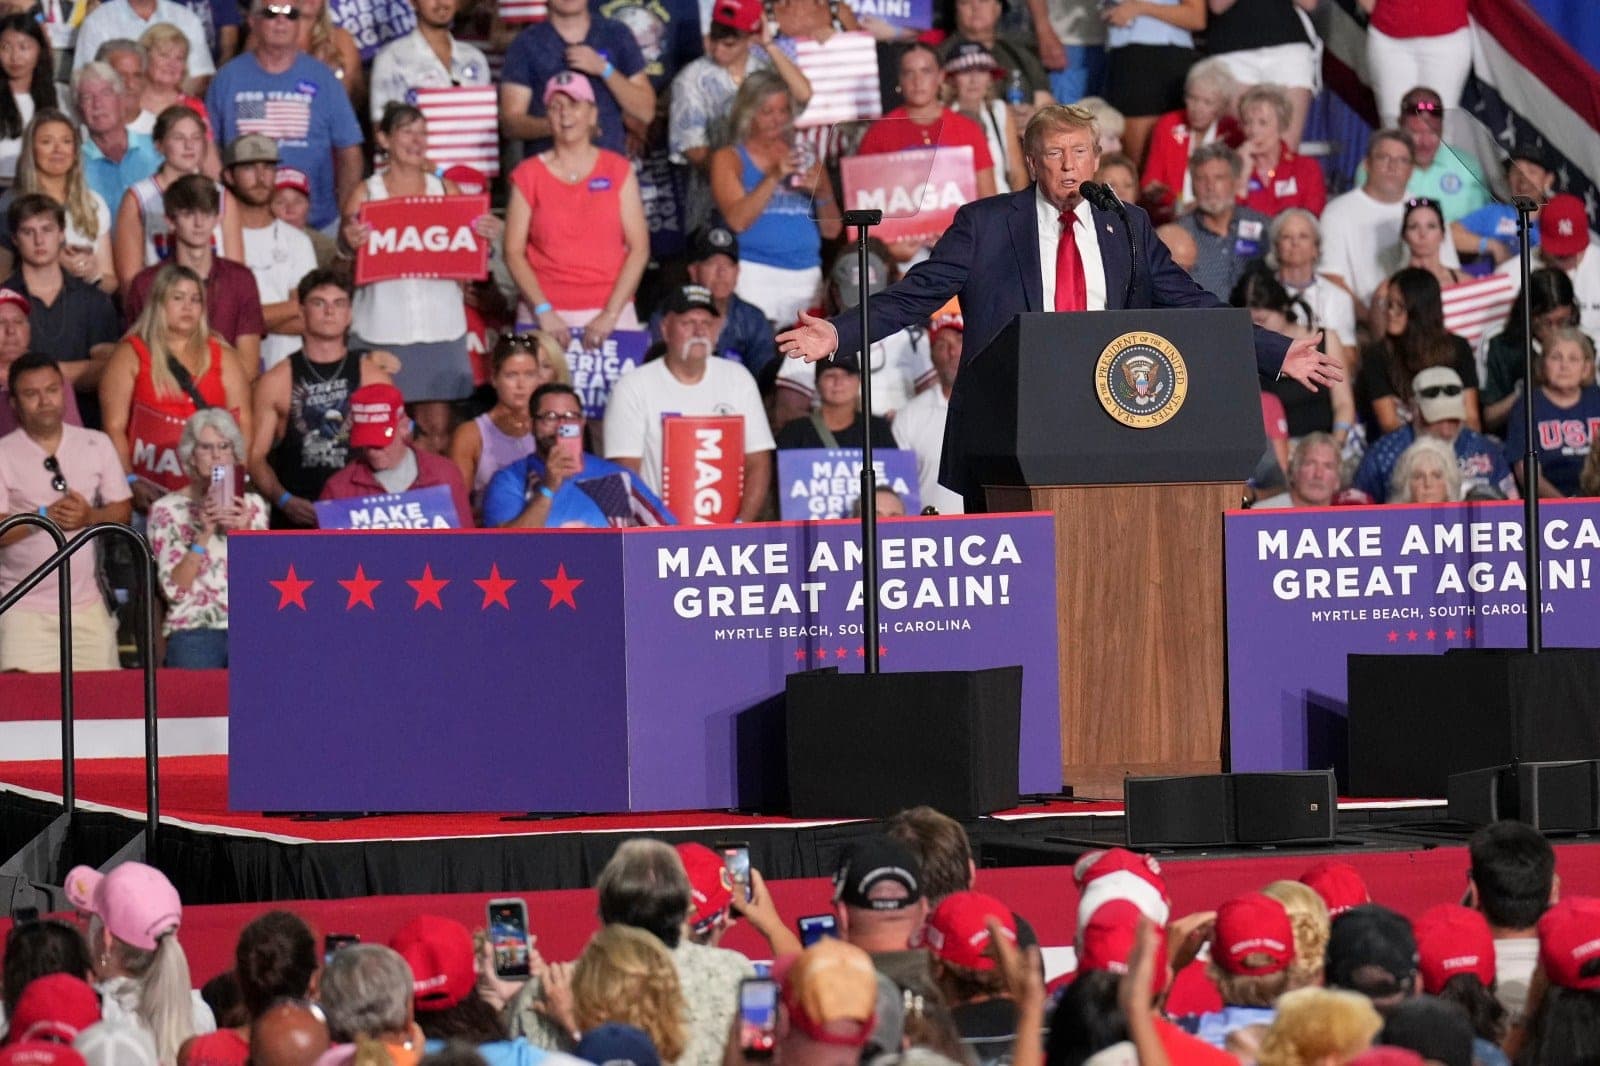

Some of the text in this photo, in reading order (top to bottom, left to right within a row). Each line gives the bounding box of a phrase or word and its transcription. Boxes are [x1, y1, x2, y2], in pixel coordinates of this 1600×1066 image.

[856, 181, 967, 215] MAGA
[367, 225, 478, 256] MAGA
[1098, 335, 1139, 378] PRESIDENT
[1150, 337, 1163, 348] THE
[1164, 346, 1185, 385] UNITED
[1112, 408, 1136, 423] SEAL
[1151, 393, 1184, 423] STATES
[133, 438, 184, 477] MA
[349, 502, 425, 527] MAKE
[657, 533, 1023, 579] MAKE AMERICA
[1257, 518, 1600, 561] MAKE AMERCA
[673, 574, 1010, 619] GREAT AGAIN!
[1272, 558, 1592, 601] GREAT AGAN!
[1311, 602, 1555, 622] MYRTLE BEACH, SOUTH CAROLA
[714, 618, 972, 641] MYRTLE BEACH, SOUH CAROLINA
